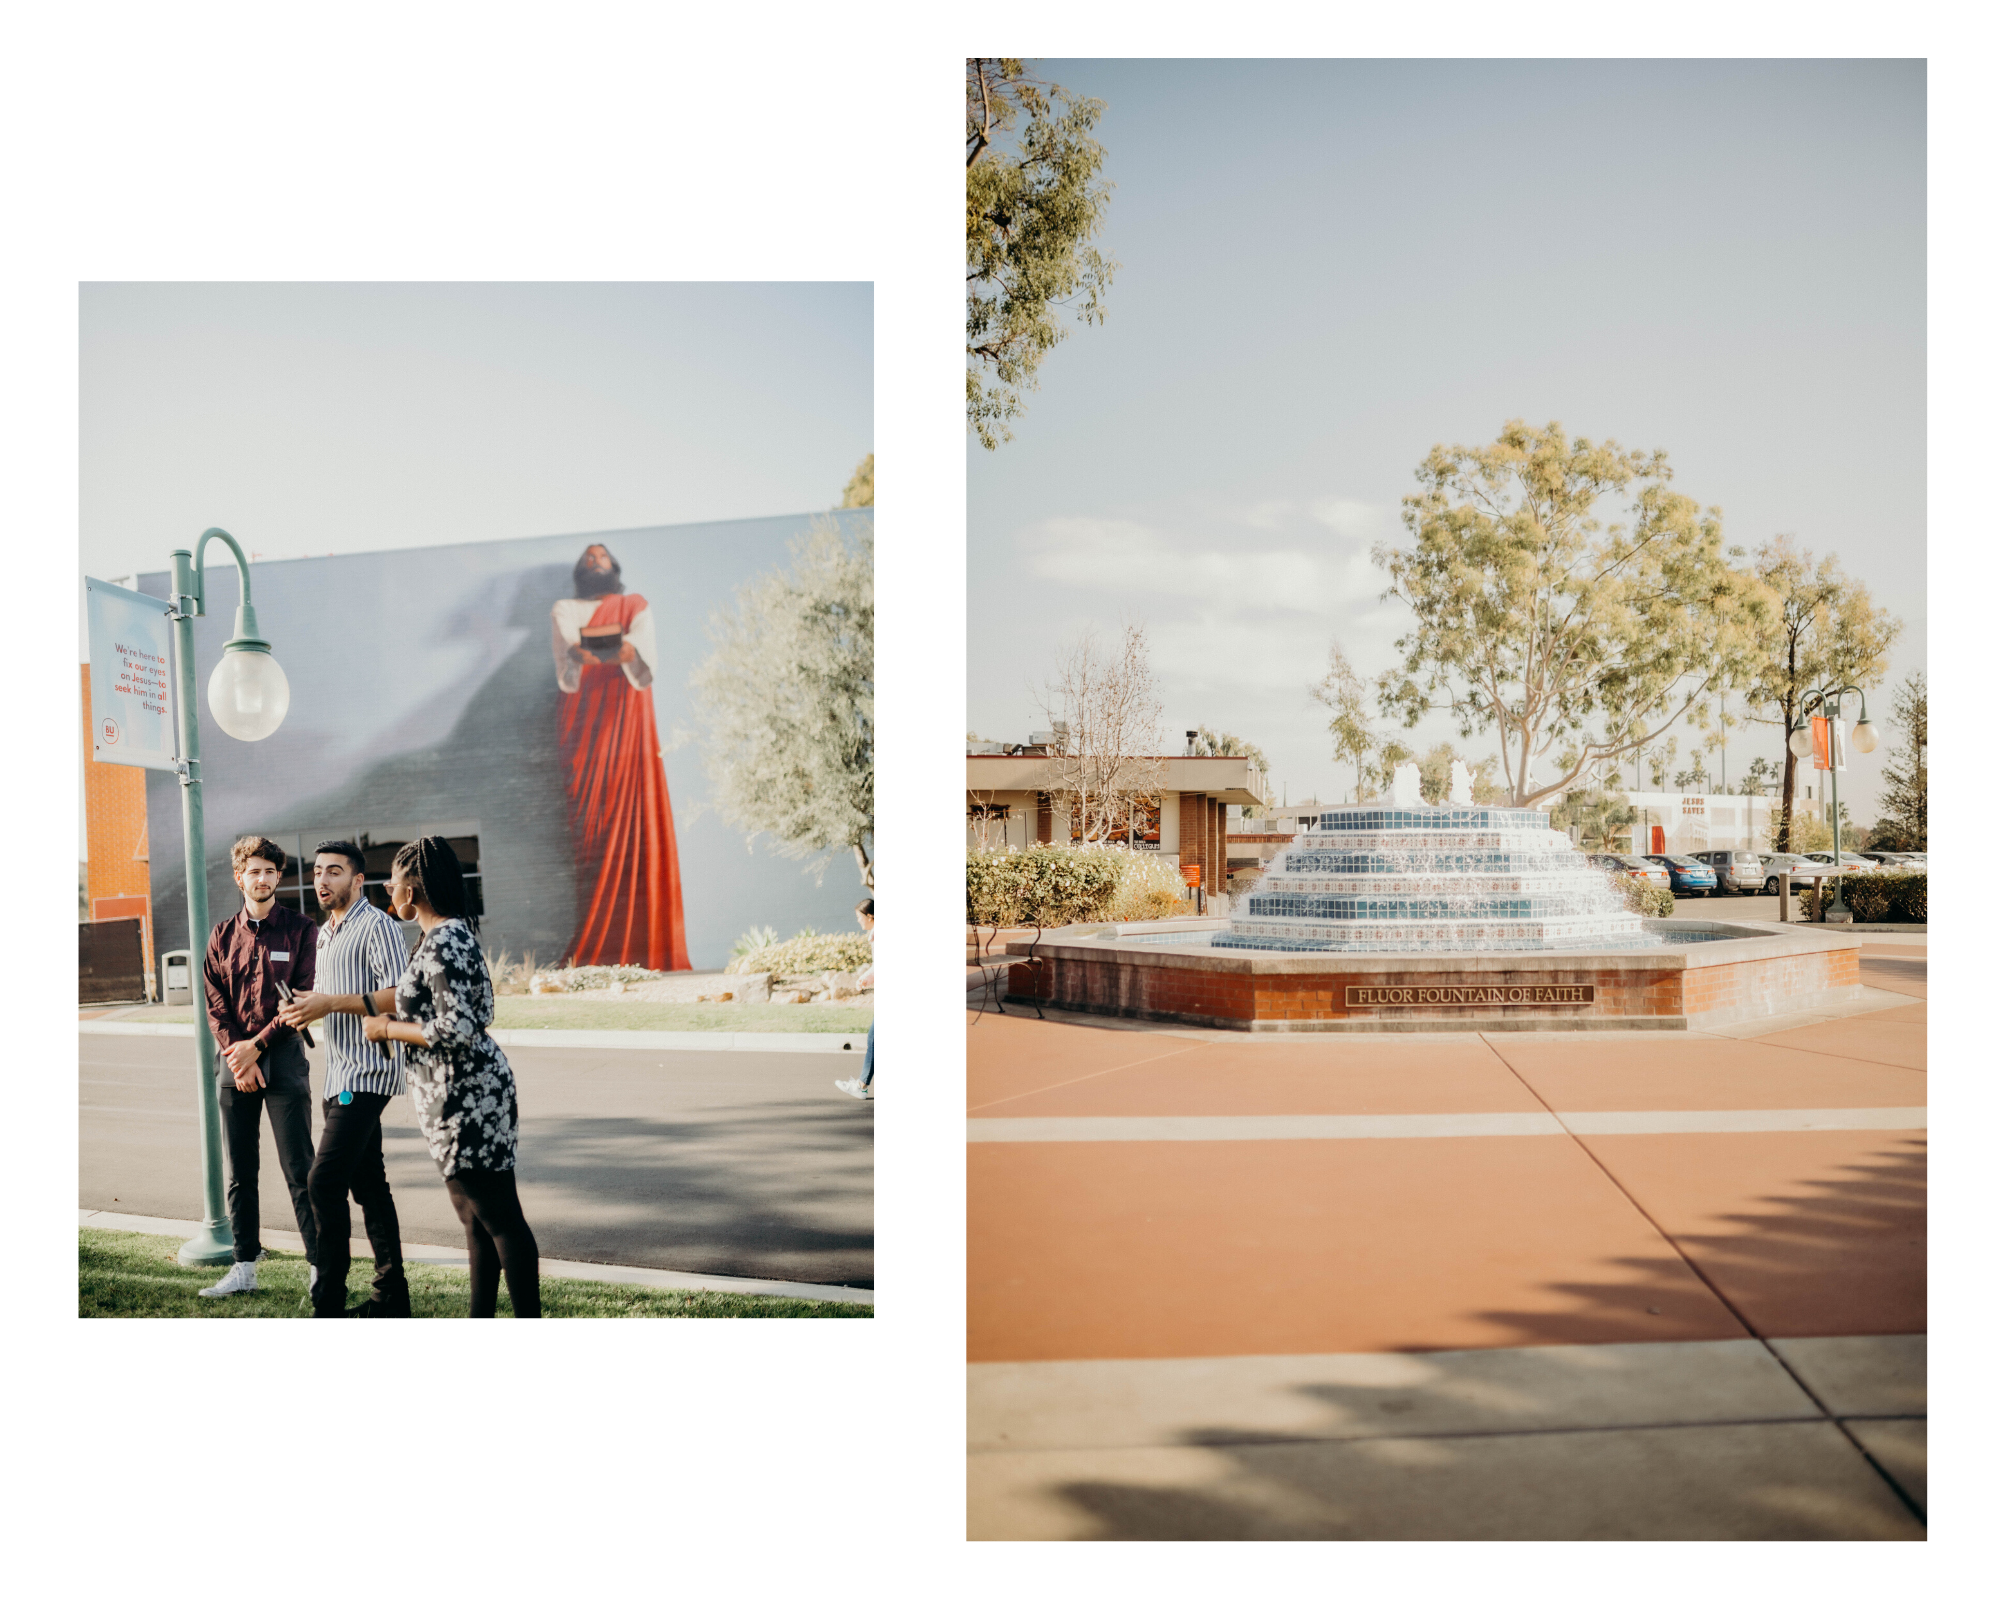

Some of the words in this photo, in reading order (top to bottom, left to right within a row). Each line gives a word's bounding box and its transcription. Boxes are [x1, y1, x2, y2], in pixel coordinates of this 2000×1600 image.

[115, 643, 138, 657] We're
[139, 649, 155, 661] here
[157, 656, 165, 664] to
[123, 657, 133, 669] fix
[135, 664, 147, 672] our
[149, 668, 165, 676] eyes
[121, 673, 130, 681] on
[115, 684, 131, 693] seek
[134, 685, 147, 697] him
[149, 689, 156, 698] in
[158, 691, 167, 700] all
[143, 701, 167, 714] things.
[105, 725, 114, 734] BU
[1357, 989, 1414, 1003] FLUOR
[1417, 987, 1505, 1003] FOUNTAIN
[1508, 987, 1531, 1002] OF
[1534, 987, 1584, 1001] FAITH
